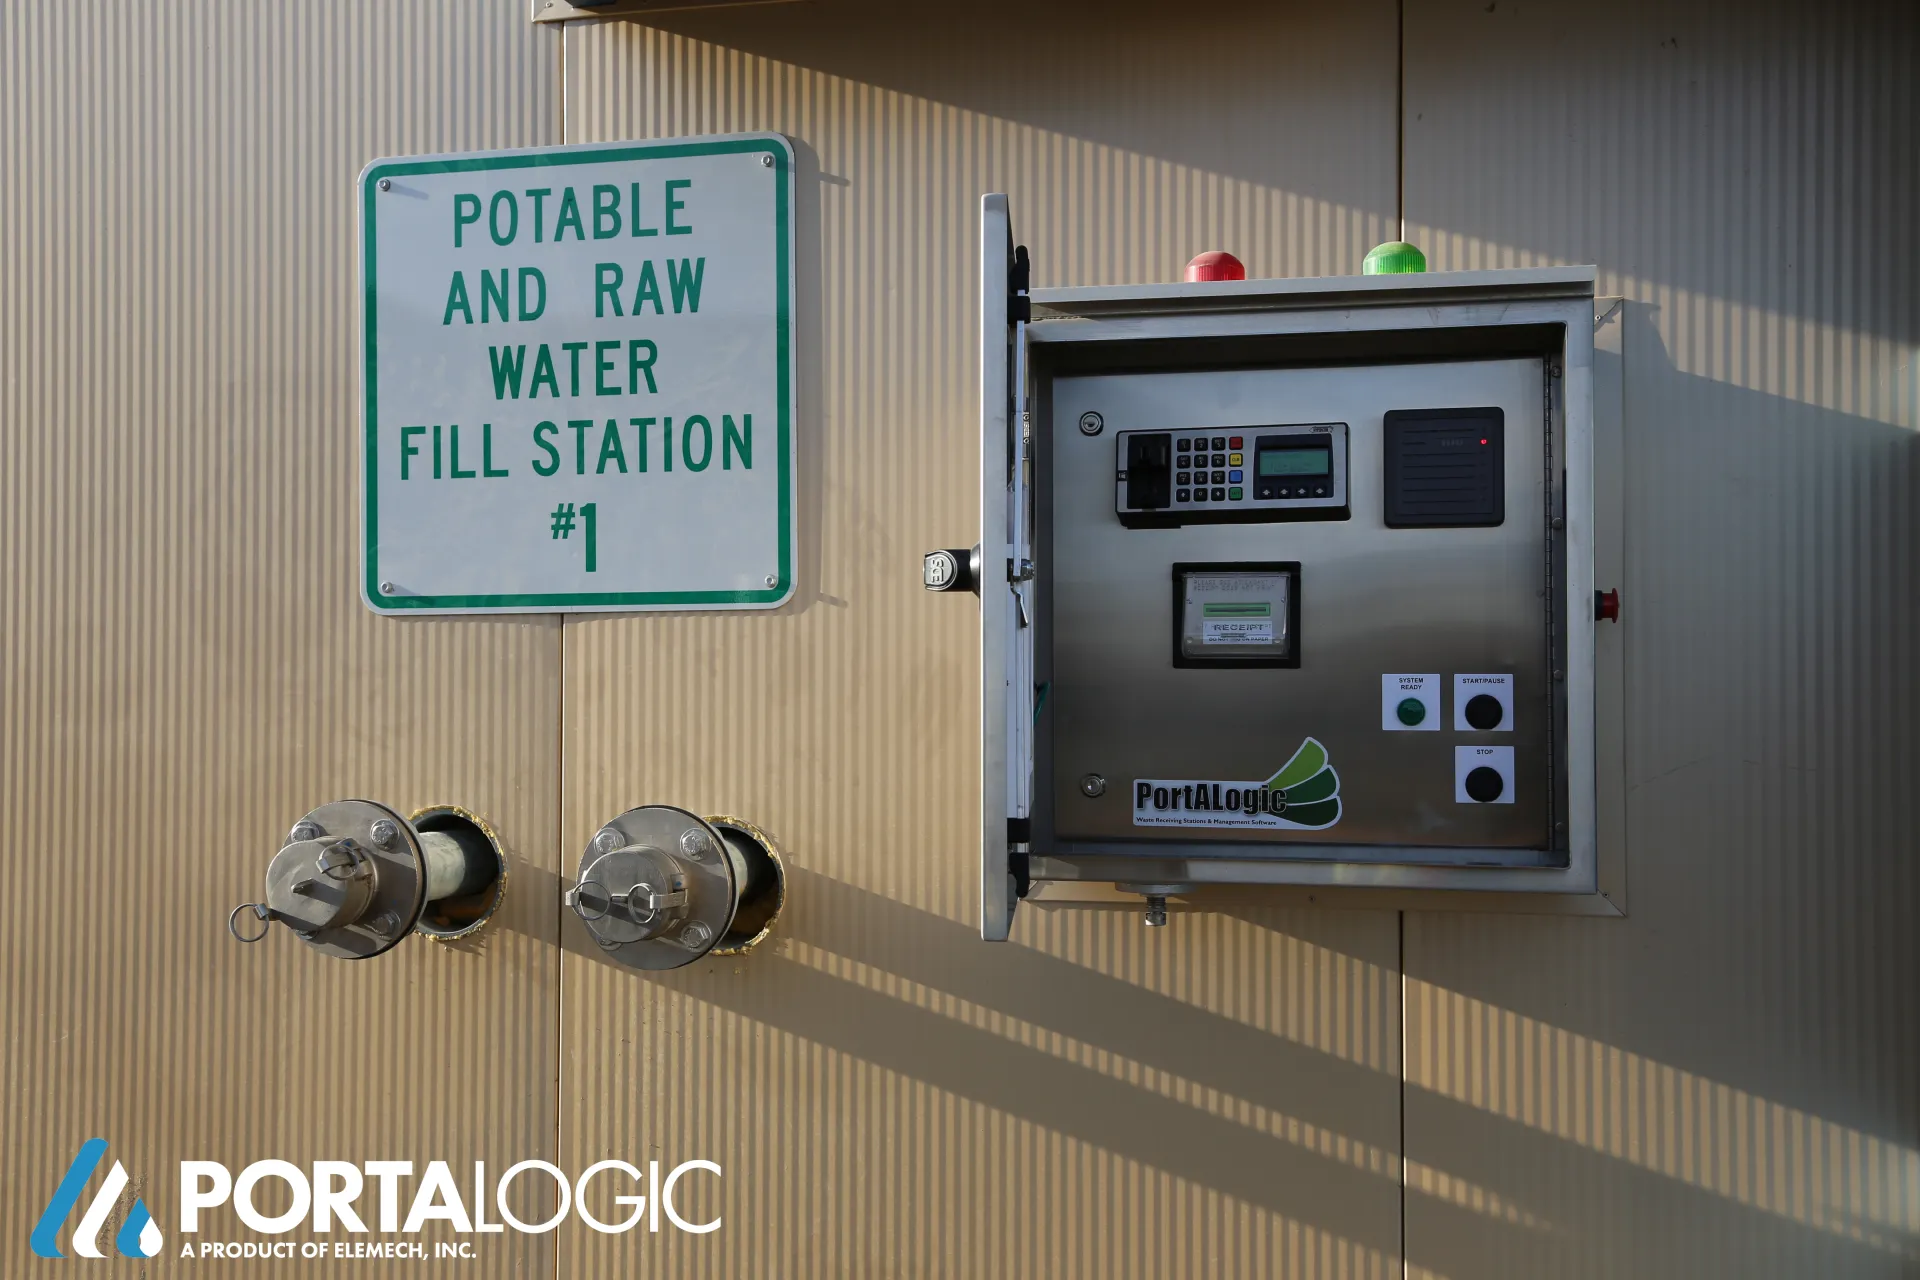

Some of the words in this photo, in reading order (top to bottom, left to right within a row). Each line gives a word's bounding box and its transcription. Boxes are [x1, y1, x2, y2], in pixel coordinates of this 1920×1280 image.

[453, 178, 693, 248] POTABLE
[443, 267, 547, 326] AND
[595, 257, 706, 318] RAW
[488, 339, 658, 401] WATER
[400, 423, 509, 480] FILL
[532, 413, 753, 477] STATION
[551, 503, 597, 573] #1
[1136, 782, 1288, 816] PortALogic
[1155, 817, 1182, 825] Receiving
